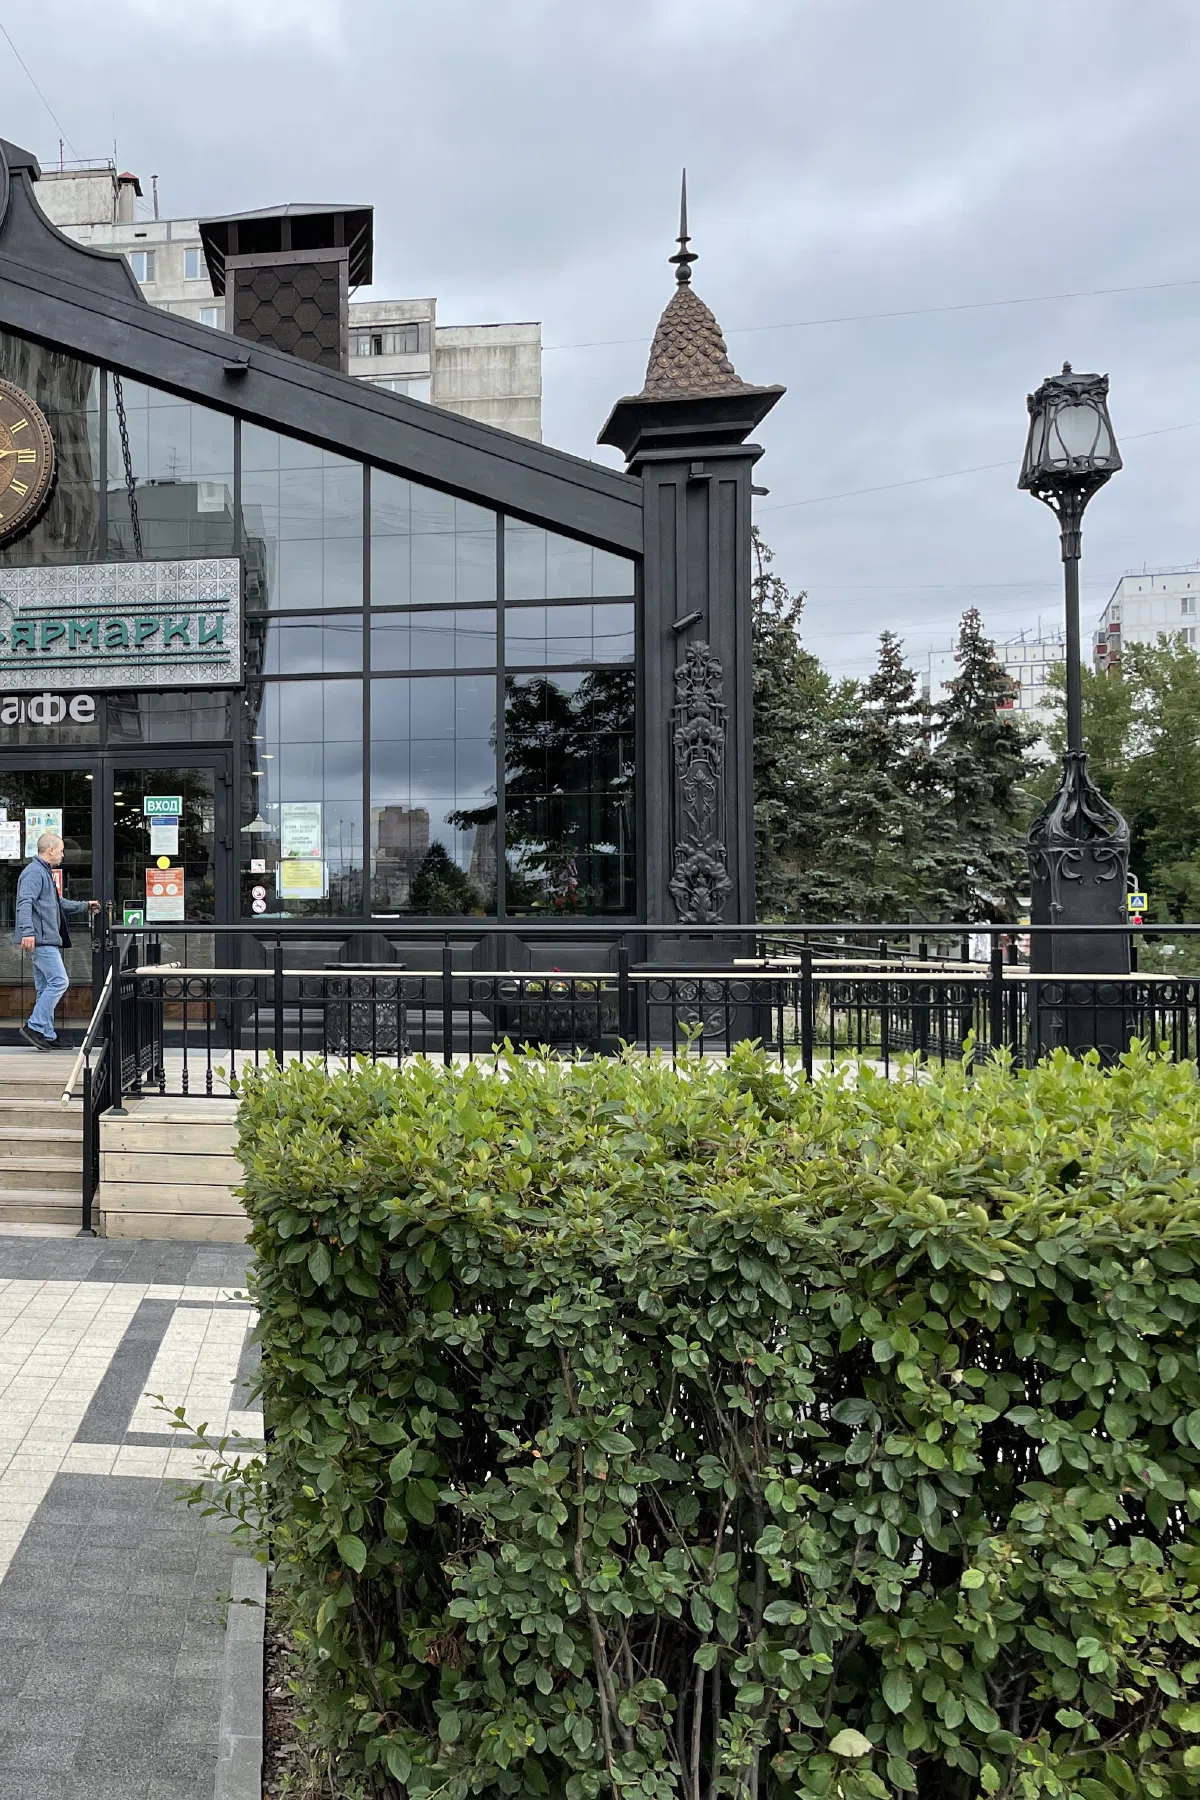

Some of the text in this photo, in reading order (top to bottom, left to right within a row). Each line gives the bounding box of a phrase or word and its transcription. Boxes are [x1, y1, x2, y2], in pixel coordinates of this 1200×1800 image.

[9, 418, 29, 435] II
[10, 615, 225, 651] ЯРМАРКИ
[147, 800, 178, 812] ВХОД
